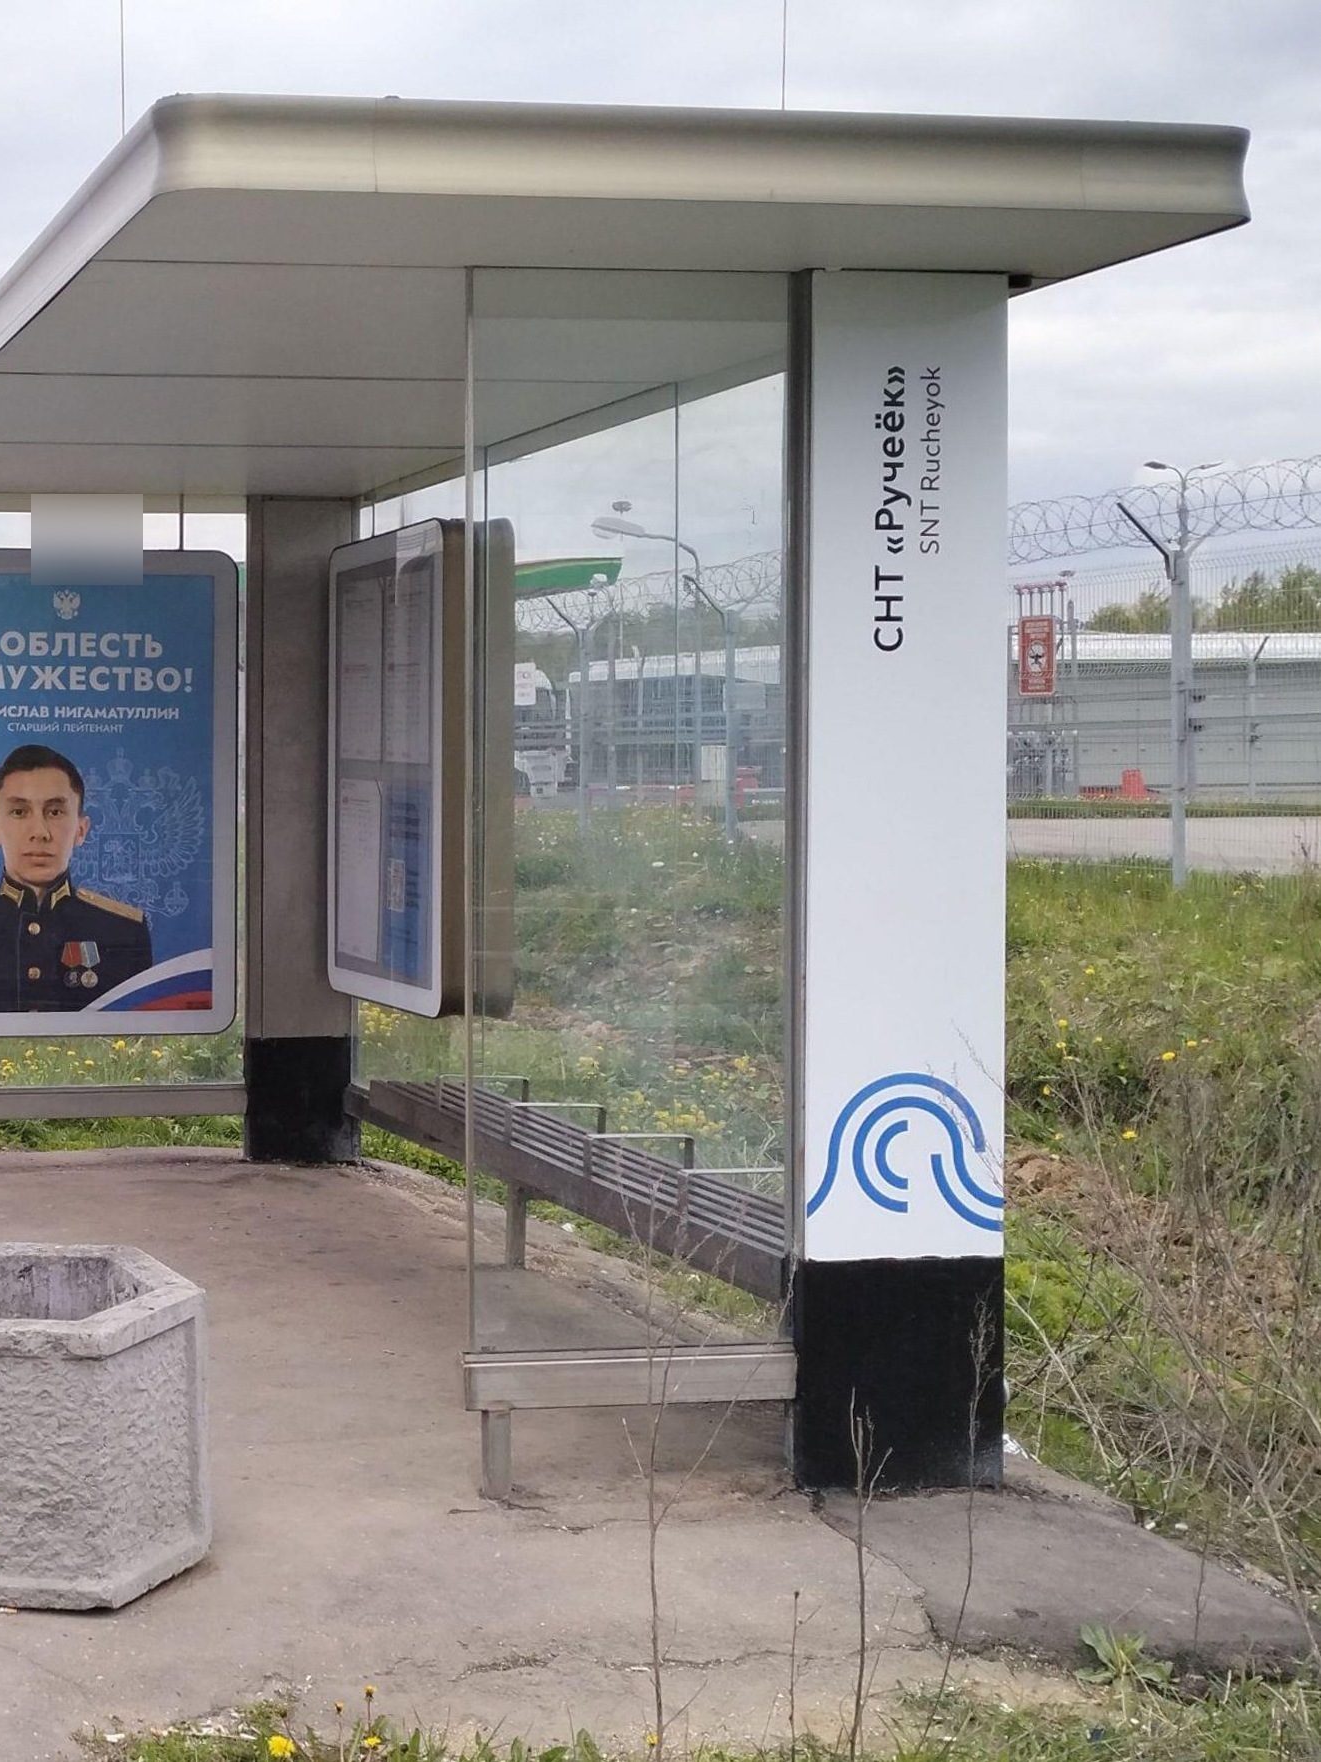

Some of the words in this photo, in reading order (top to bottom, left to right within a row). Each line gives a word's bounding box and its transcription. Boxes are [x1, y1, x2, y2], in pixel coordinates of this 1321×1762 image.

[874, 365, 912, 555] «Ручеёк»
[919, 366, 946, 491] Rucheyok
[919, 499, 941, 554] SNT
[873, 564, 904, 652] СНТ
[7, 721, 60, 733] СТАРШИЙ
[63, 721, 125, 734] ЛЕЙТЕНАНТ
[54, 705, 180, 720] НИГАМАТУЛЛИН
